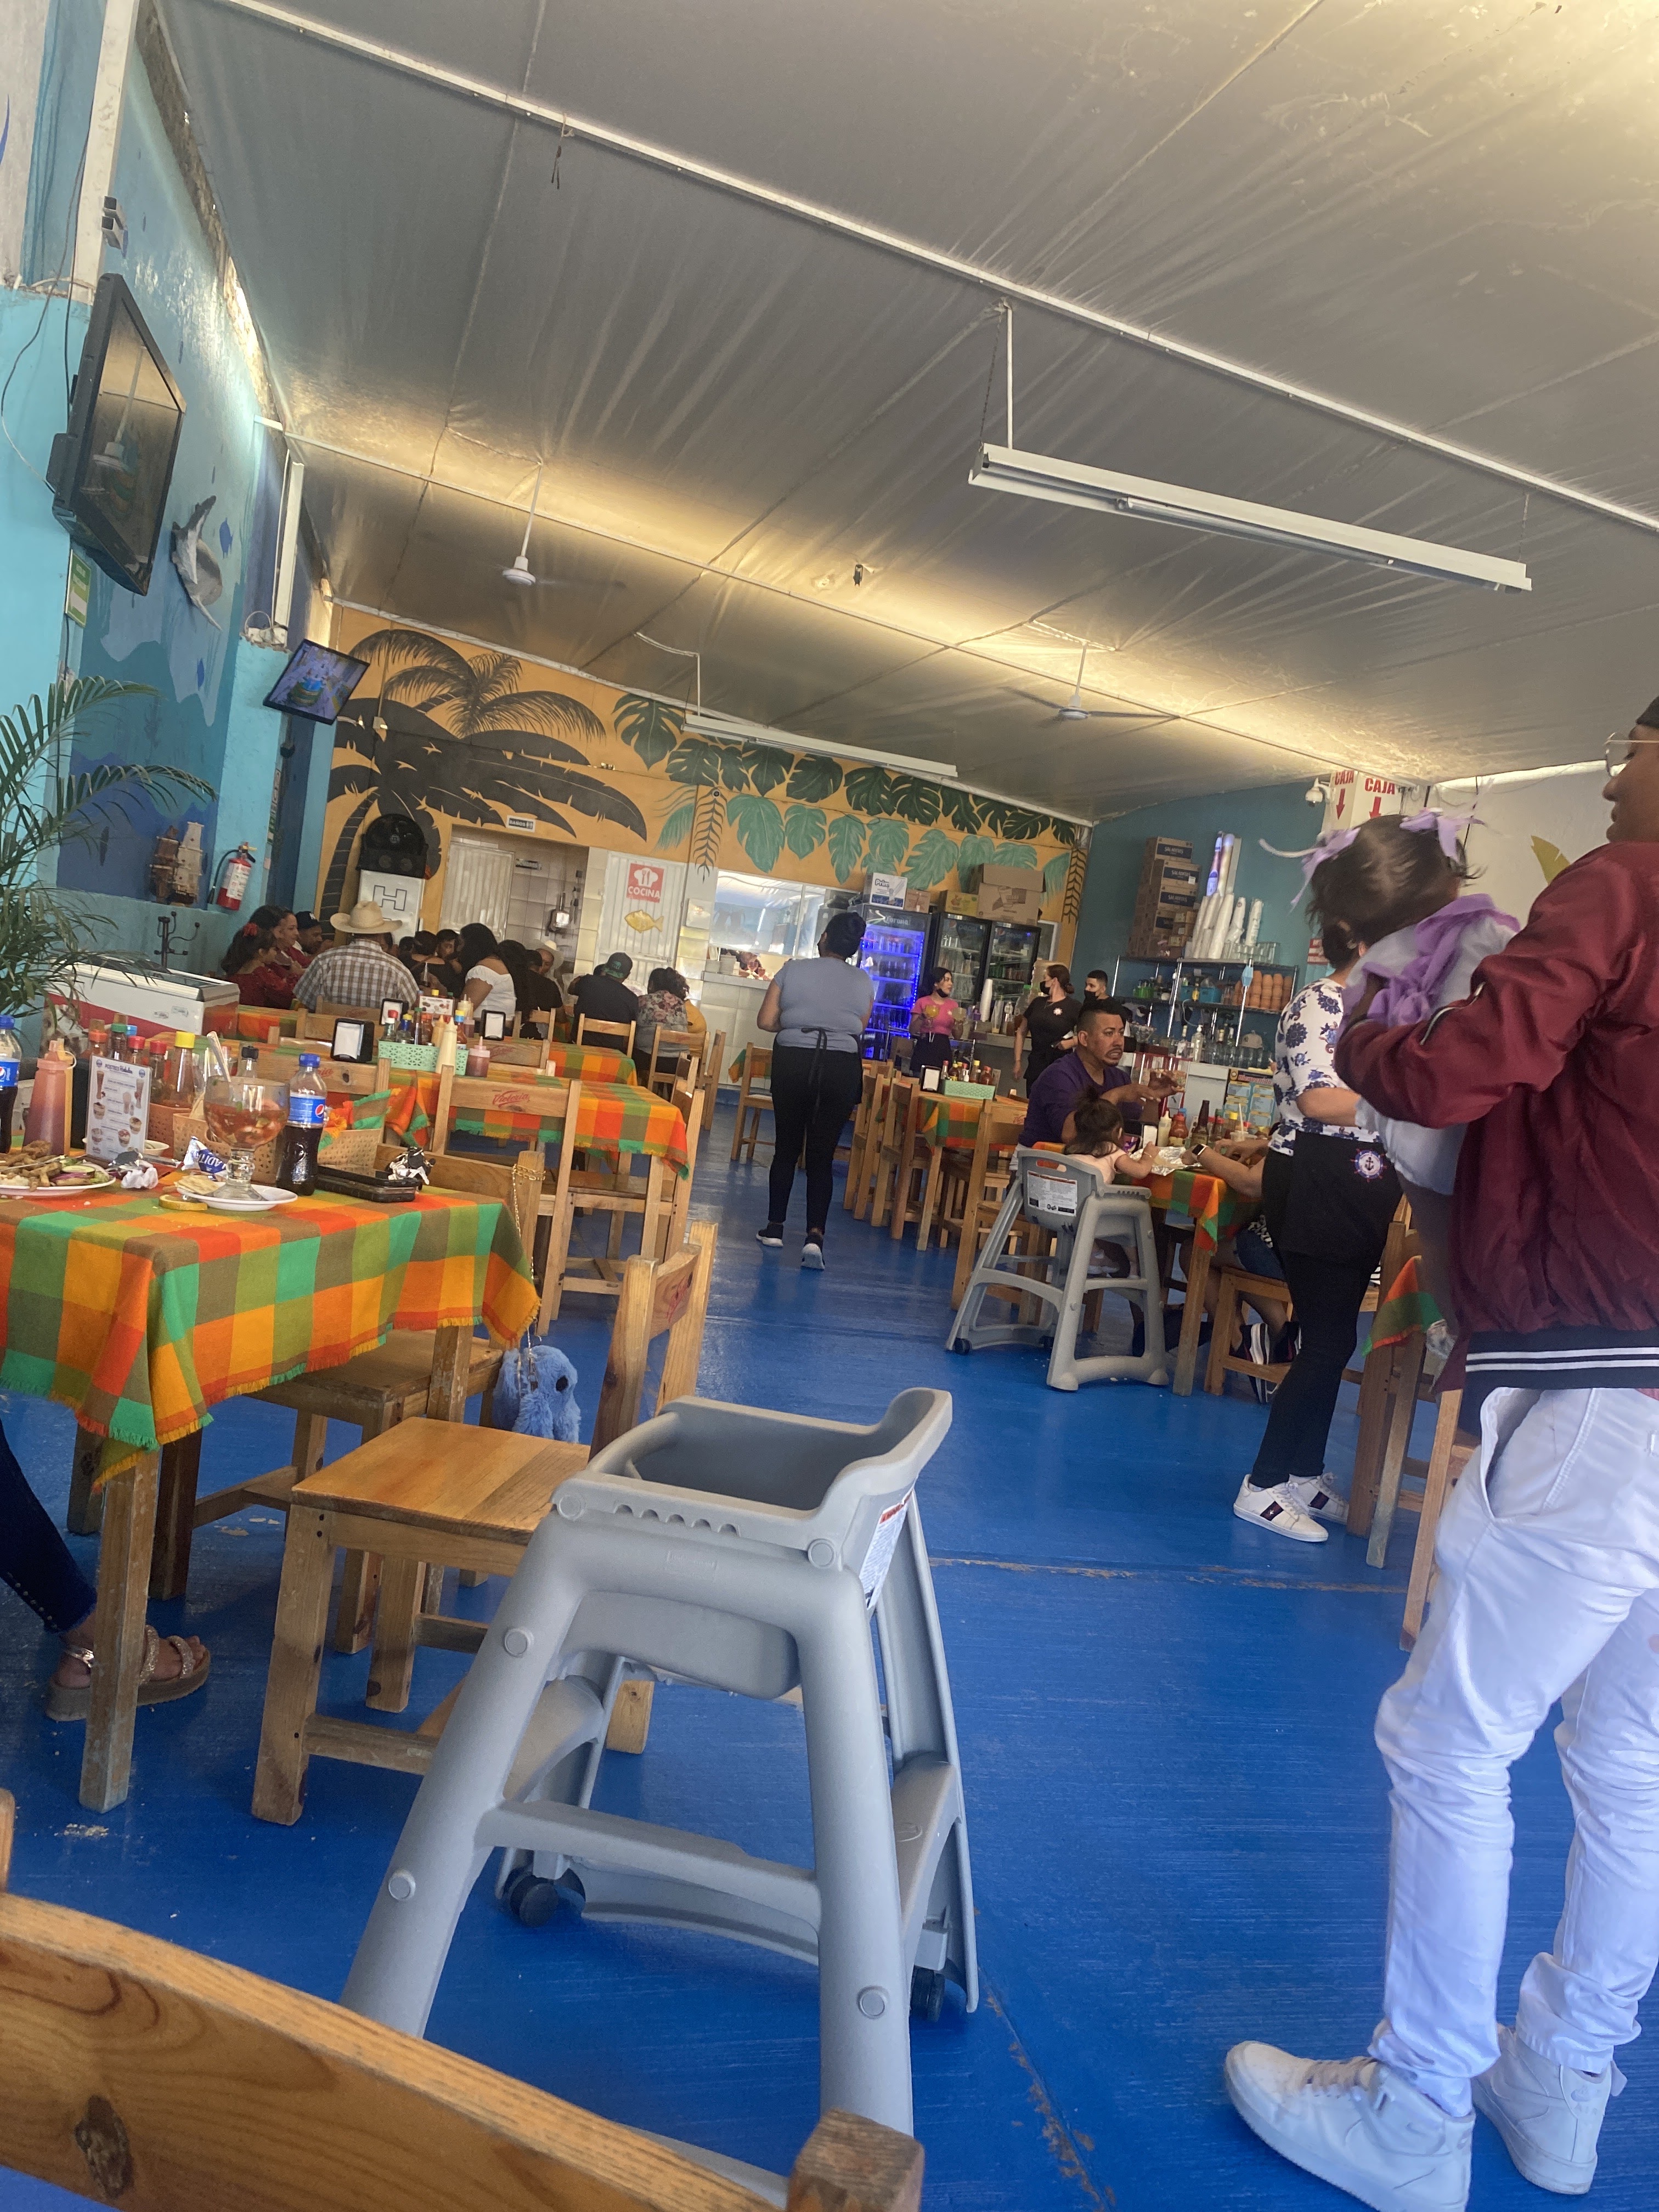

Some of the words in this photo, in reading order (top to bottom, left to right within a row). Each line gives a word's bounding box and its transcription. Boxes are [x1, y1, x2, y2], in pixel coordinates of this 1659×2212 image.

[1334, 770, 1355, 786] CAJA
[1364, 777, 1395, 795] CAJA
[628, 885, 661, 899] COCINA
[492, 1090, 530, 1109] Victoria
